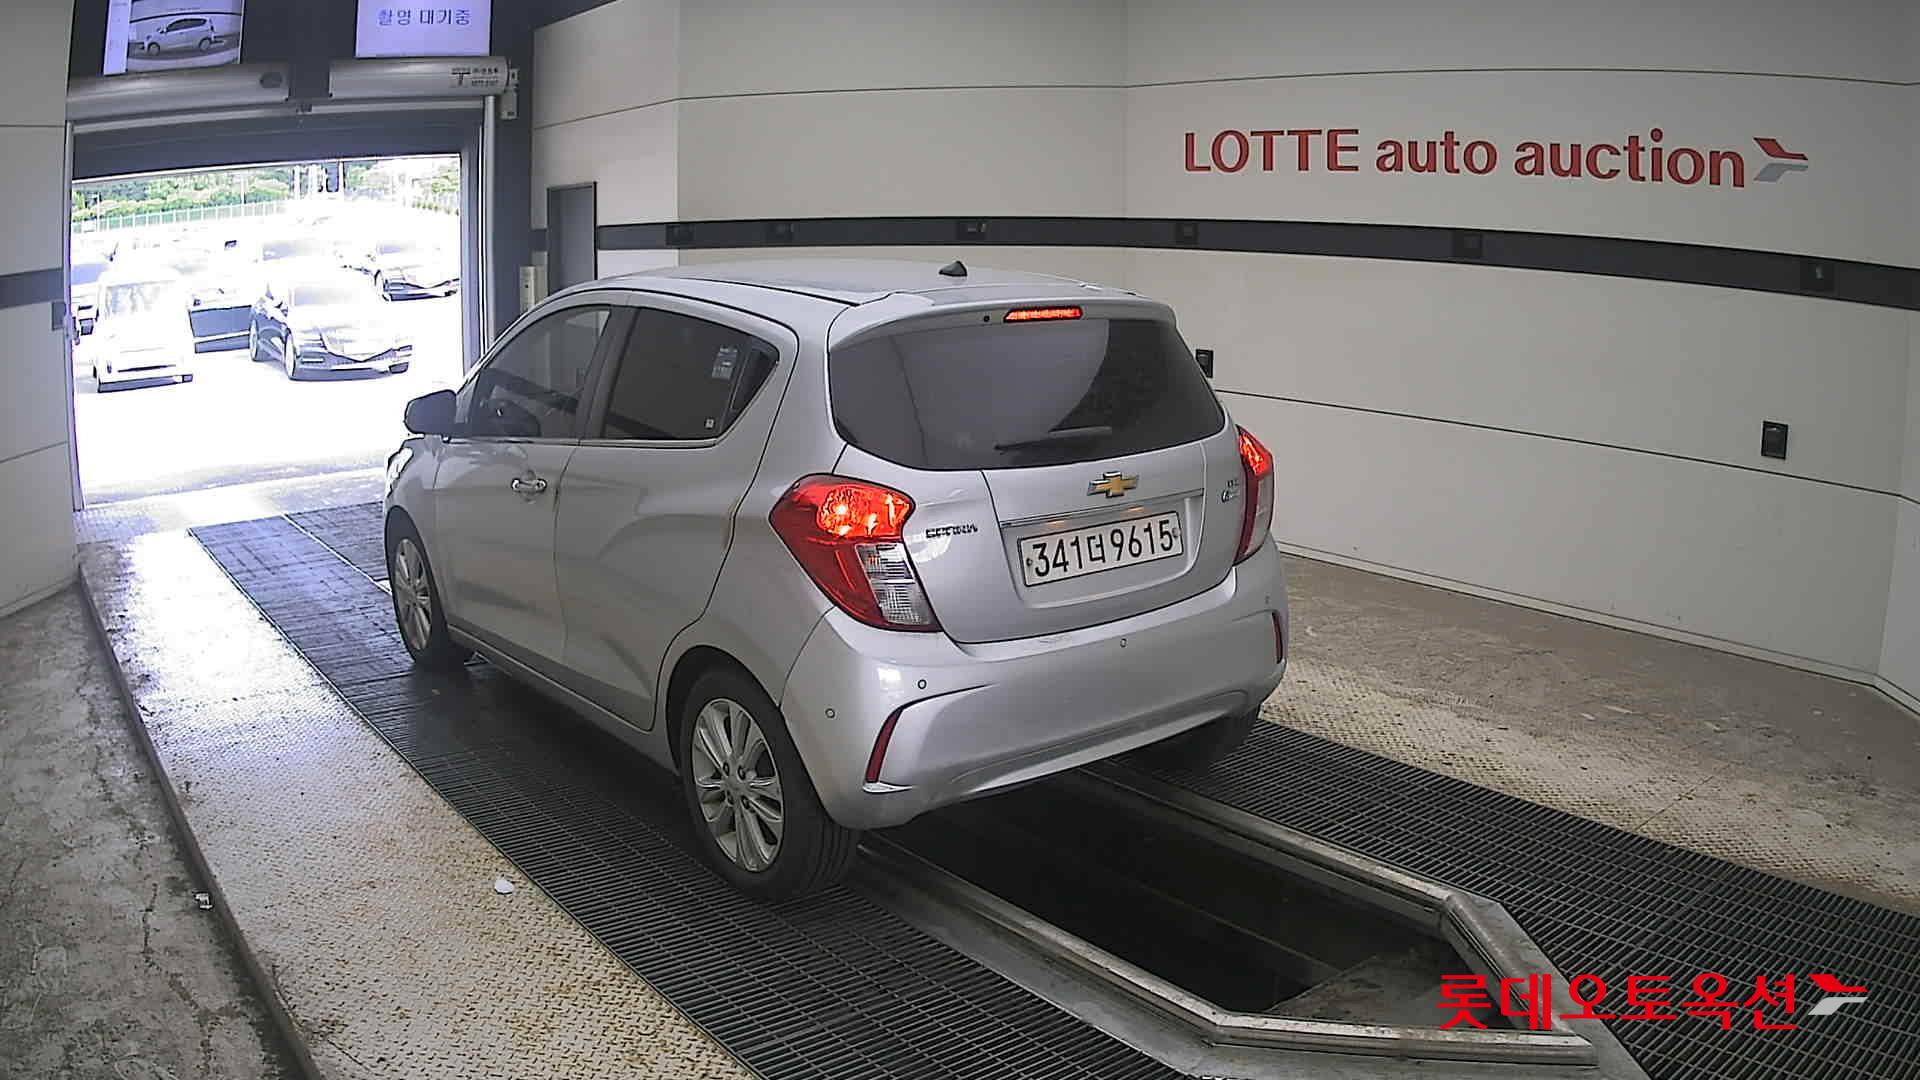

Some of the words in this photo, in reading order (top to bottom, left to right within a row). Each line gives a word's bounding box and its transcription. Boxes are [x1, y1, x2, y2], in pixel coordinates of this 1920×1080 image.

[420, 8, 471, 26] 대기중
[1184, 129, 1360, 172] LOTTE
[1375, 131, 1498, 174] auto
[1513, 128, 1744, 188] auction
[1032, 519, 1174, 578] 341더9615
